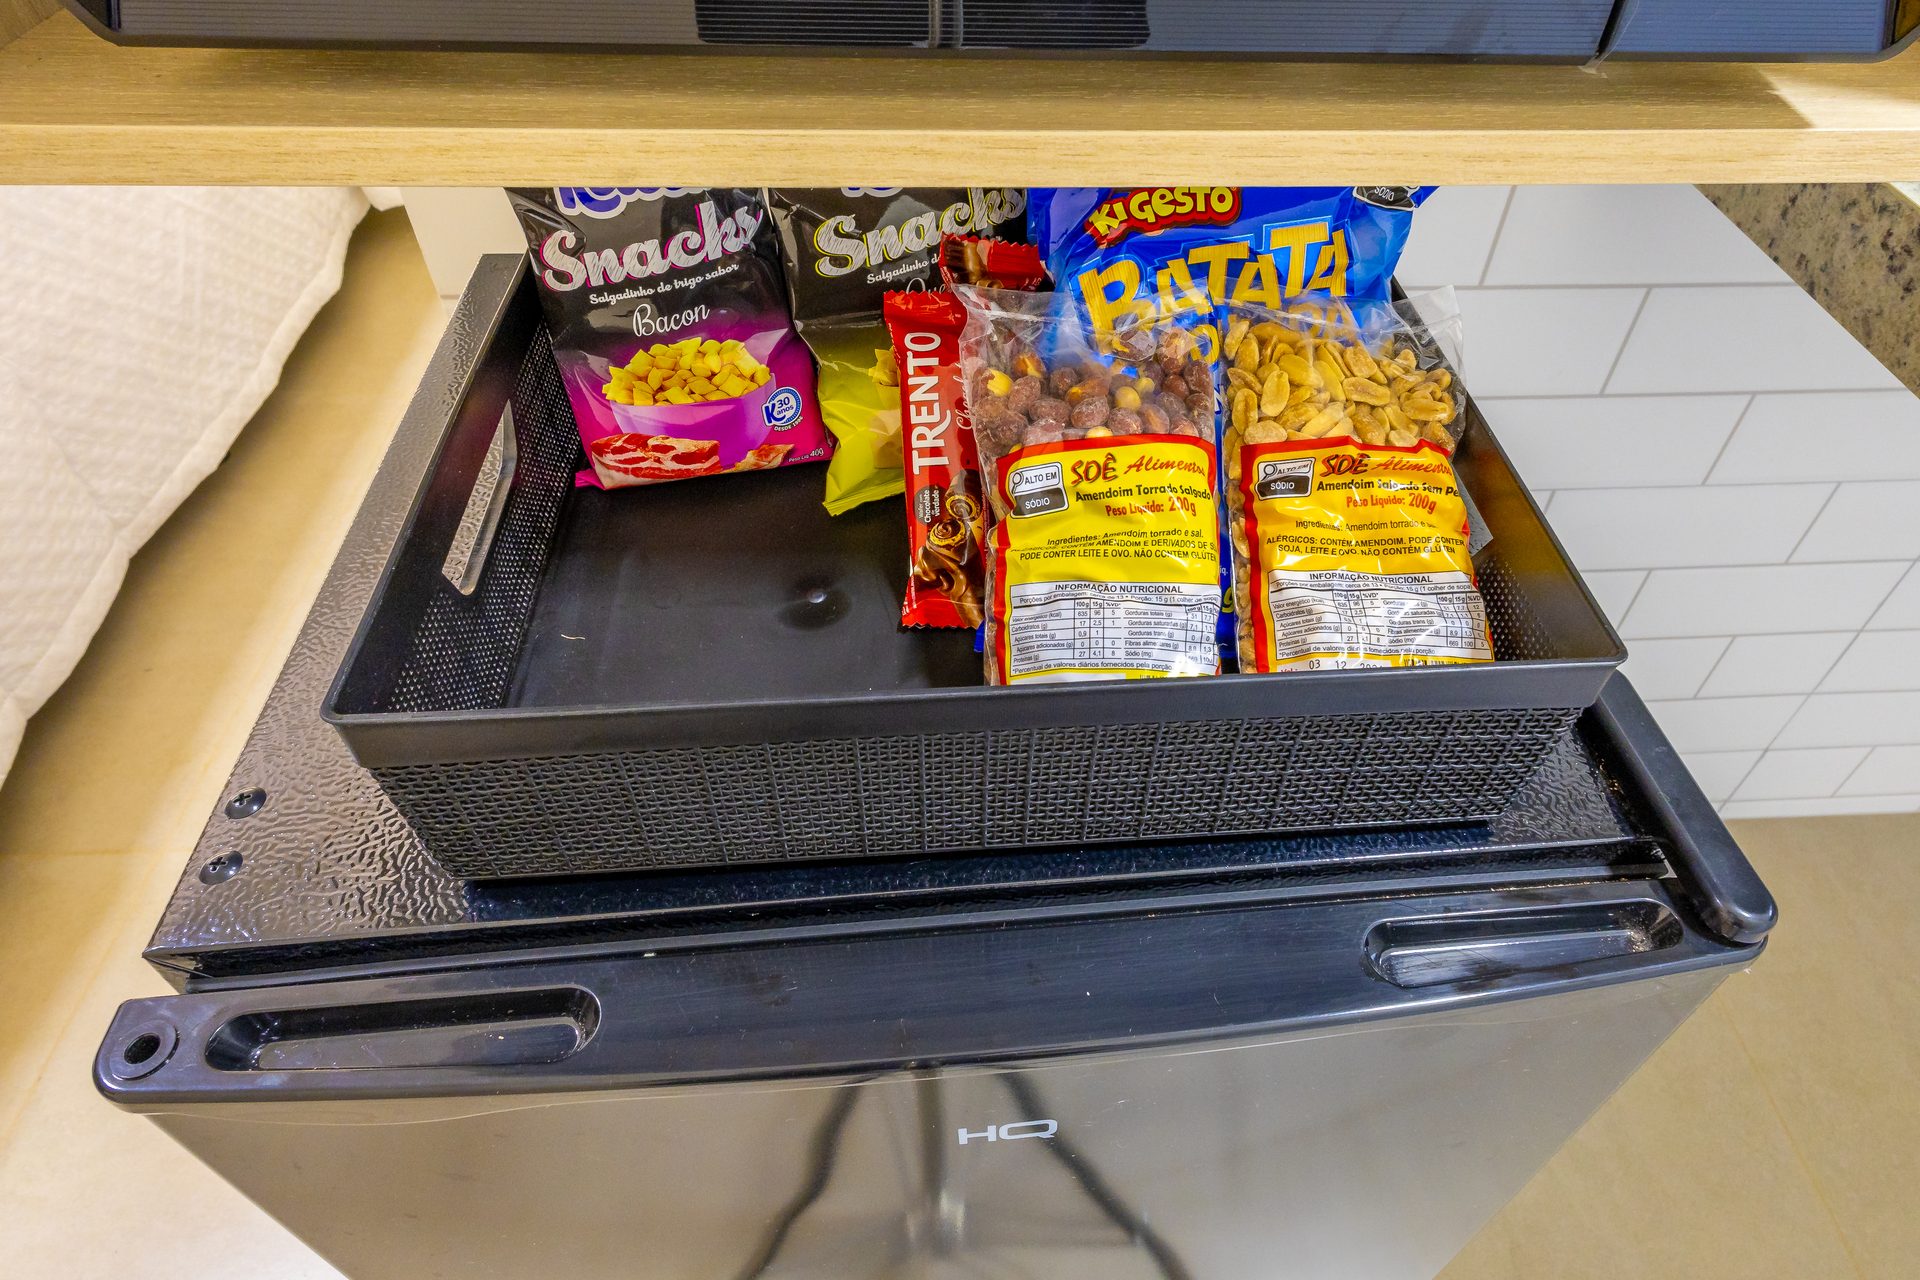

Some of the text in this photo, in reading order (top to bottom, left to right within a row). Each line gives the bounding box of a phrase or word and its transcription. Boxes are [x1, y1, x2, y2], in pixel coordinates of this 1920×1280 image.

[814, 187, 1027, 278] Snacks
[540, 200, 763, 293] Snacks
[866, 259, 930, 284] Salgadinho
[930, 253, 941, 265] d
[589, 262, 740, 306] Salgadinho de trigo sabor
[1079, 222, 1349, 354] BATATA
[632, 303, 711, 337] Bacon
[776, 396, 791, 409] 30
[904, 332, 952, 476] TRENTO
[776, 405, 795, 416] anos
[1070, 452, 1119, 487] SOÊ
[1024, 471, 1058, 485] ALTO EM
[1075, 483, 1211, 502] Amendoim Torrado Salgado
[1317, 478, 1375, 492] Amendoim
[1421, 481, 1443, 496] Sem
[1025, 497, 1050, 509] SÓDIO
[1105, 504, 1128, 517] Peso
[1168, 496, 1197, 517] 200g
[1346, 496, 1369, 508] Peso
[1408, 492, 1437, 515] 200g
[1345, 520, 1388, 532] Amendoim
[1047, 528, 1203, 546] Ingredientes: Amendoim torrado sal.
[1266, 534, 1466, 548] ALÉRGICOS: CONTÉM AMENDOIM. PODE CONTER
[1095, 538, 1141, 547] AMENDOIM
[1151, 538, 1196, 548] DERIVADOS
[1197, 541, 1208, 550] DE
[1278, 544, 1303, 554] SOJA,
[1305, 546, 1329, 555] LEITE
[1331, 547, 1337, 556] E
[1338, 548, 1360, 556] OVO.
[1361, 548, 1380, 557] NÃO
[1382, 544, 1421, 556] CONTÉM
[1020, 551, 1041, 560] PODE
[1043, 550, 1076, 559] CONTER
[1078, 549, 1101, 558] LEITE
[1103, 549, 1109, 557] E
[1111, 549, 1132, 558] OVO.
[1134, 547, 1153, 558] NÃO
[1309, 573, 1433, 584] INFORMAÇÃO NUTRICIONAL
[1055, 582, 1183, 593] INFORMAÇÃO NUTRICIONAL
[1427, 584, 1446, 592] colher
[1446, 583, 1456, 591] de
[1020, 596, 1044, 604] Porções
[1043, 595, 1053, 603] por
[1273, 602, 1286, 610] Valor
[1275, 608, 1306, 619] Carboidratos
[1011, 623, 1040, 633] Carboidratos
[1303, 625, 1332, 634] adicionados
[1035, 641, 1065, 649] adicionados
[1124, 649, 1140, 657] Sódio
[1077, 660, 1100, 668] diários
[1151, 663, 1173, 671] porção
[1308, 659, 1347, 670] 03 12
[957, 1119, 1058, 1145] HQ
